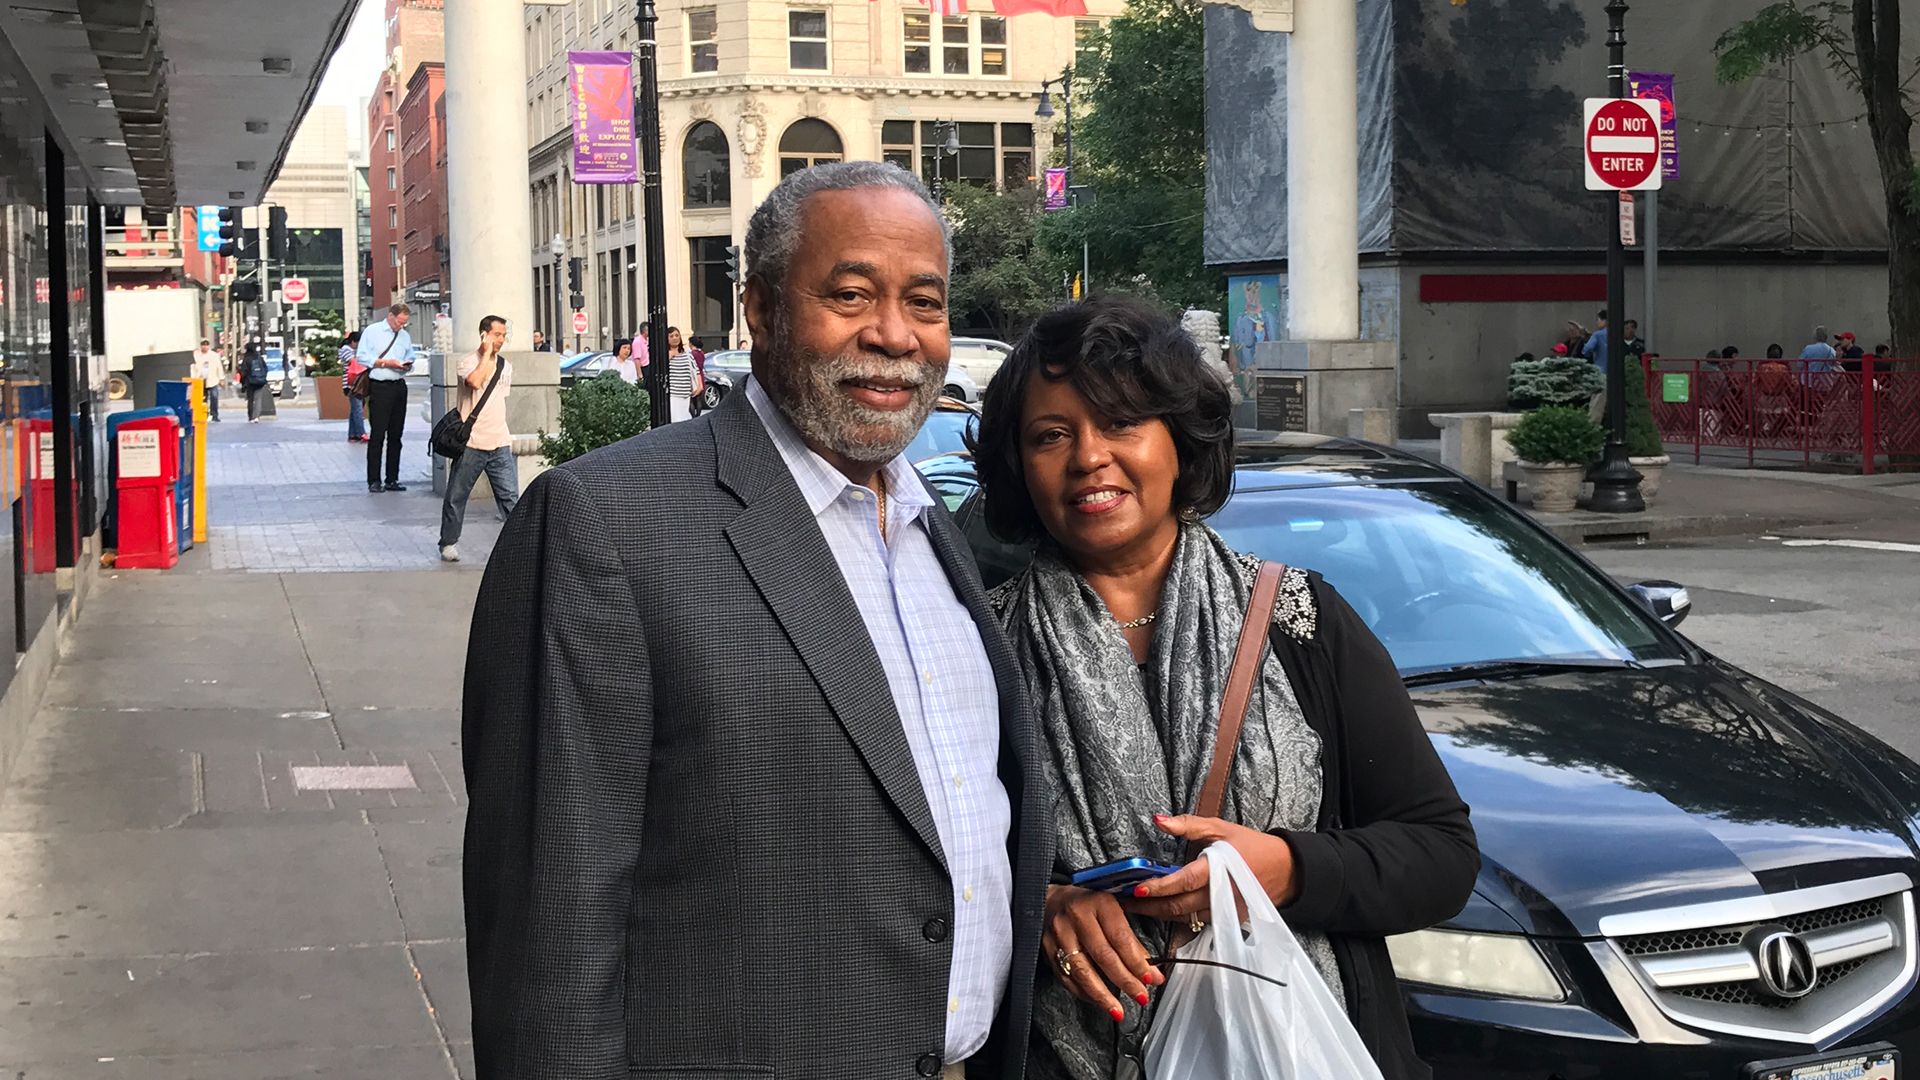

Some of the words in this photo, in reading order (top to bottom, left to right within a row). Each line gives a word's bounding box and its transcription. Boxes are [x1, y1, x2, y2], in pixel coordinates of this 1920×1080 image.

[575, 65, 588, 130] WELCOME
[1597, 117, 1615, 131] DO
[1622, 117, 1649, 132] NOT
[598, 133, 632, 141] EXPLORE
[1601, 157, 1644, 172] ENTER
